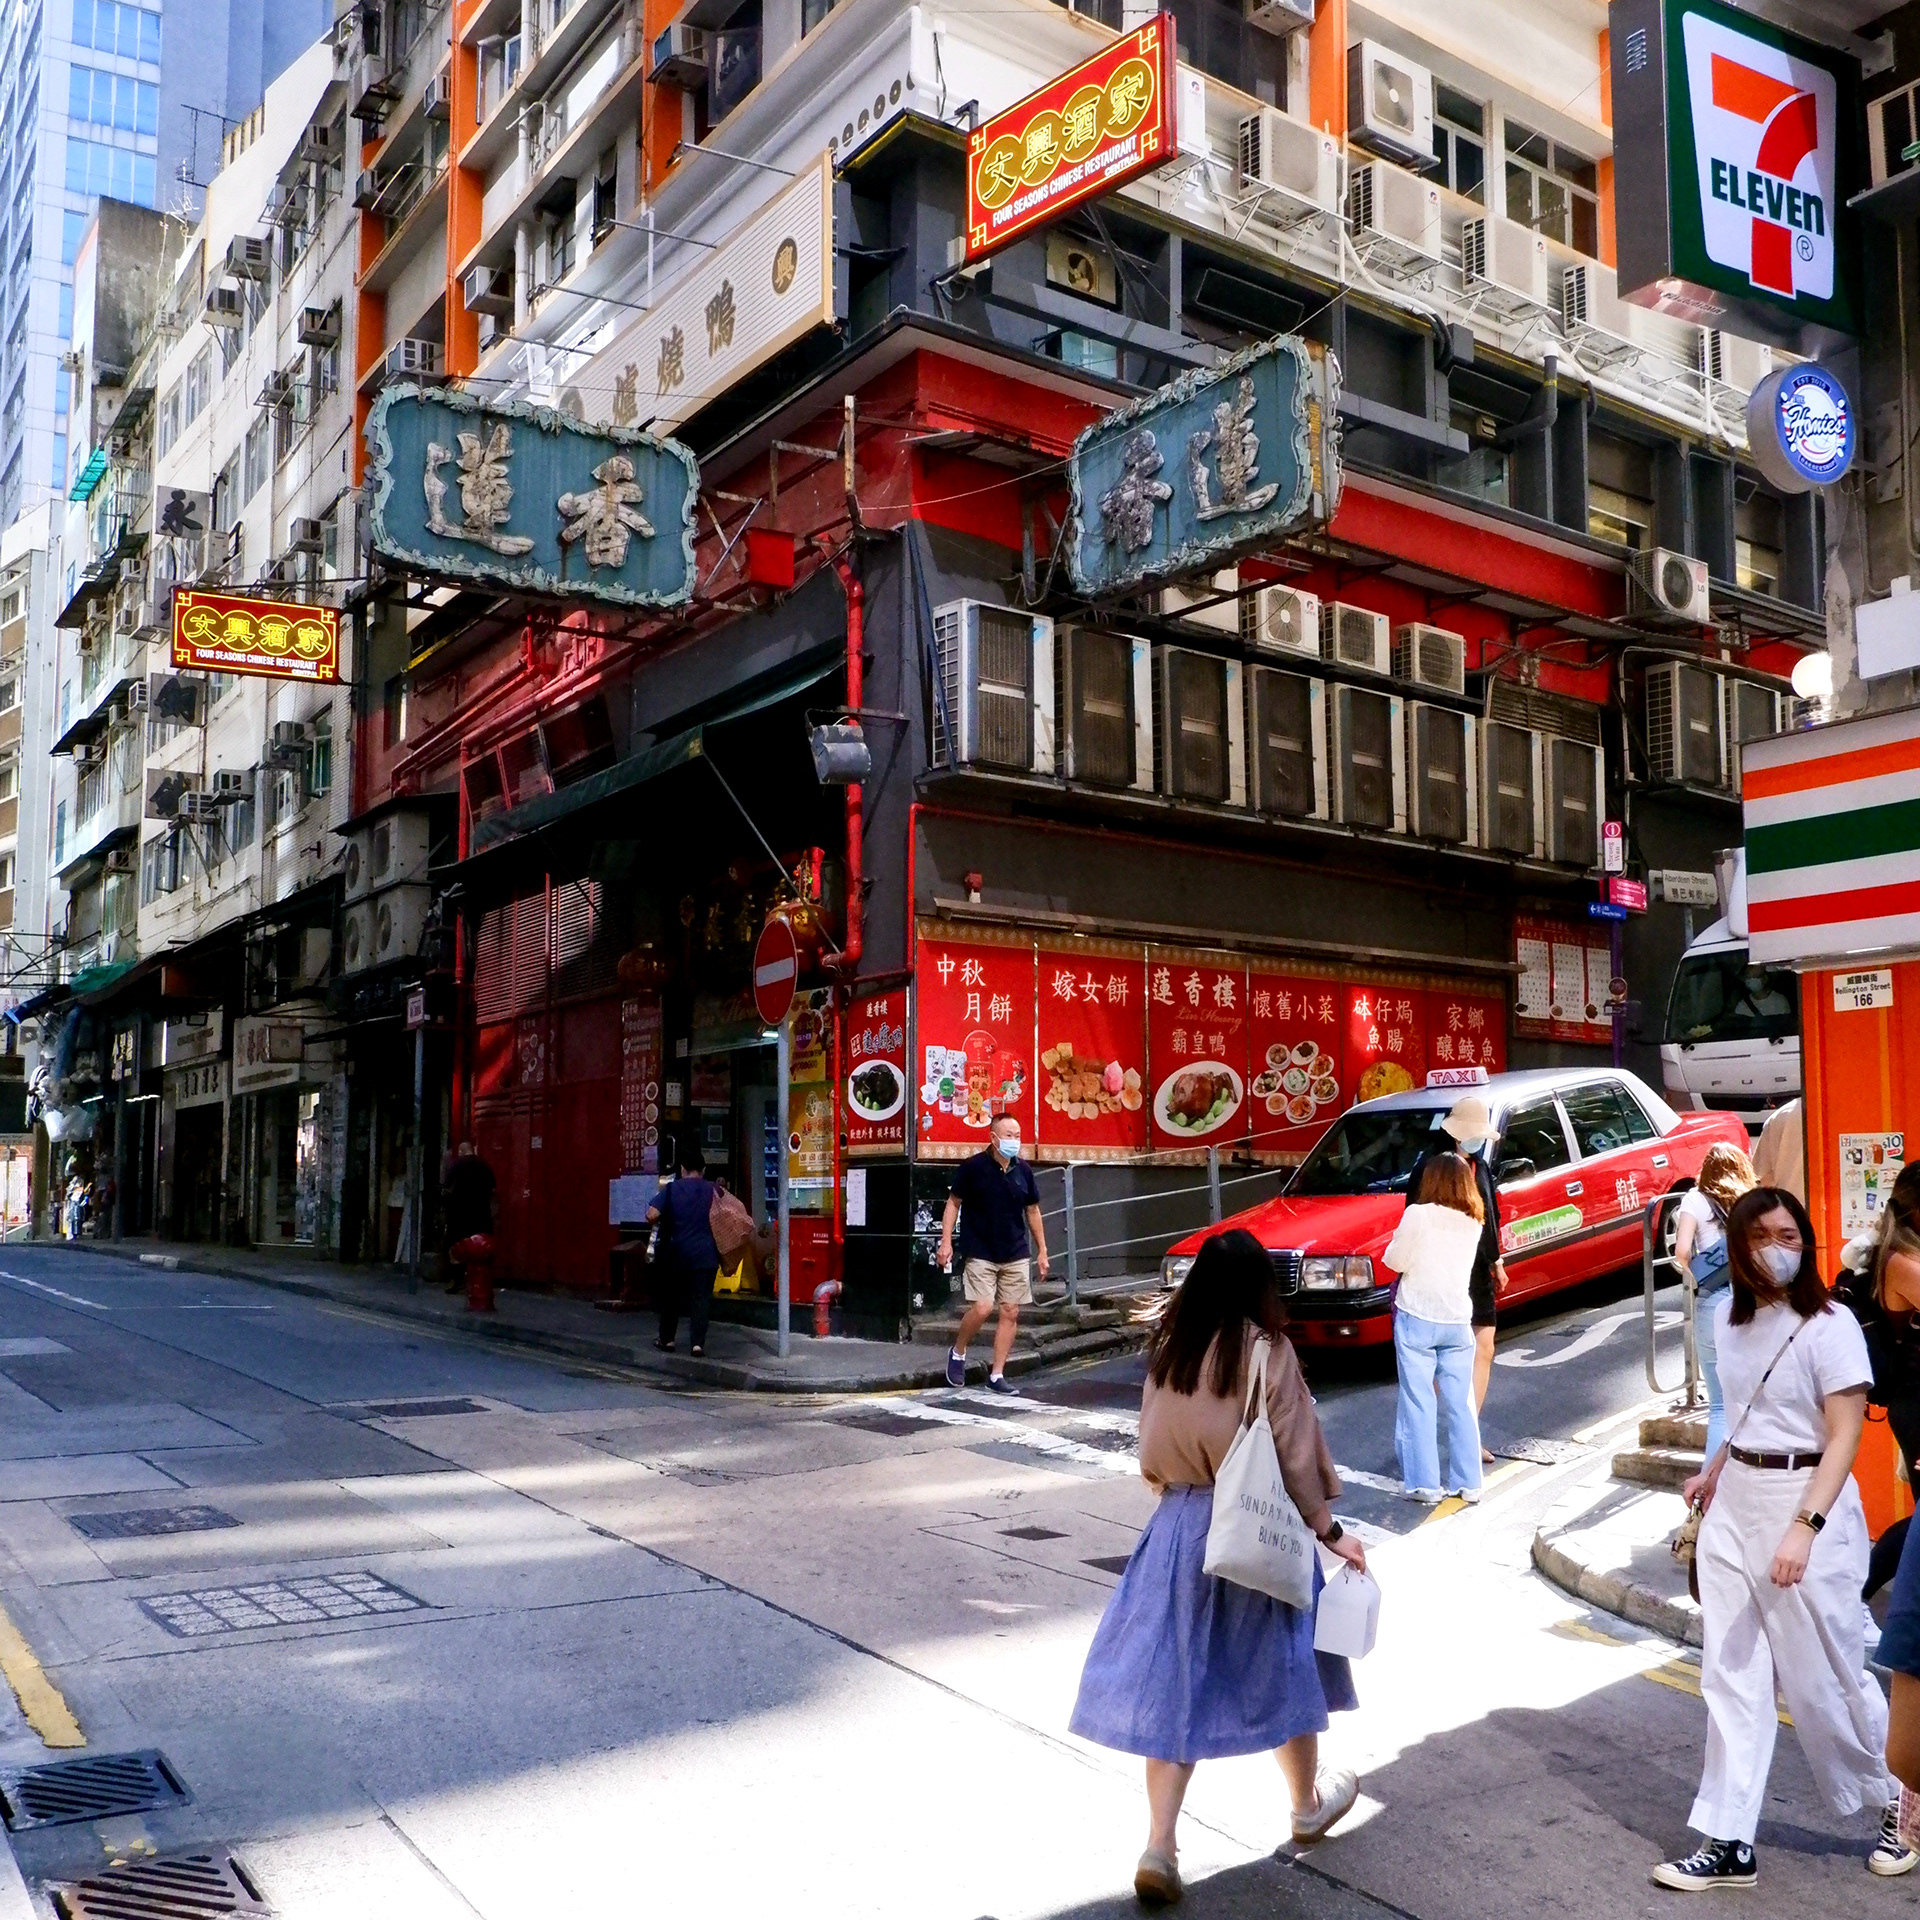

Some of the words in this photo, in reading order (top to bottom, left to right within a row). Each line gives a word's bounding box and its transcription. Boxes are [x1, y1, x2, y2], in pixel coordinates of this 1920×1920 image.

[982, 71, 1147, 200] 文興酒家
[1104, 153, 1140, 178] CENTRAL
[992, 204, 1014, 227] FOUR
[1013, 183, 1050, 216] SEASONS
[1049, 166, 1084, 196] CHINESE
[1084, 135, 1137, 176] RESTAURANT
[1786, 404, 1846, 445] Homies
[186, 613, 327, 653] 文興酒家
[196, 648, 214, 659] FOUR
[215, 651, 247, 664] SEASONS
[247, 655, 275, 667] CHINESE
[276, 659, 317, 671] RESTAURANT
[1664, 873, 1690, 884] Aberdeen
[1691, 875, 1709, 885] Street
[937, 953, 986, 987] 中秋
[1051, 970, 1130, 1007] 嫁女餅
[1152, 966, 1237, 1010] 蓮香樓
[1835, 986, 1868, 995] Wellington
[1870, 982, 1891, 991] Street
[1854, 993, 1873, 1007] 166
[963, 992, 1013, 1025] 月餅
[1252, 989, 1335, 1024] 懷舊小菜
[1447, 1003, 1485, 1034] 家鄉
[1172, 1028, 1226, 1057] 霸皇鴨
[1366, 1025, 1404, 1054] 魚腸
[1430, 1069, 1477, 1085] TAXI
[1711, 1076, 1787, 1087] FUS
[1882, 1135, 1901, 1149] $10
[1615, 1175, 1637, 1195] 的士
[1617, 1191, 1640, 1214] TAXI
[1240, 1493, 1282, 1520] SUNDAY
[1258, 1525, 1288, 1552] BLING
